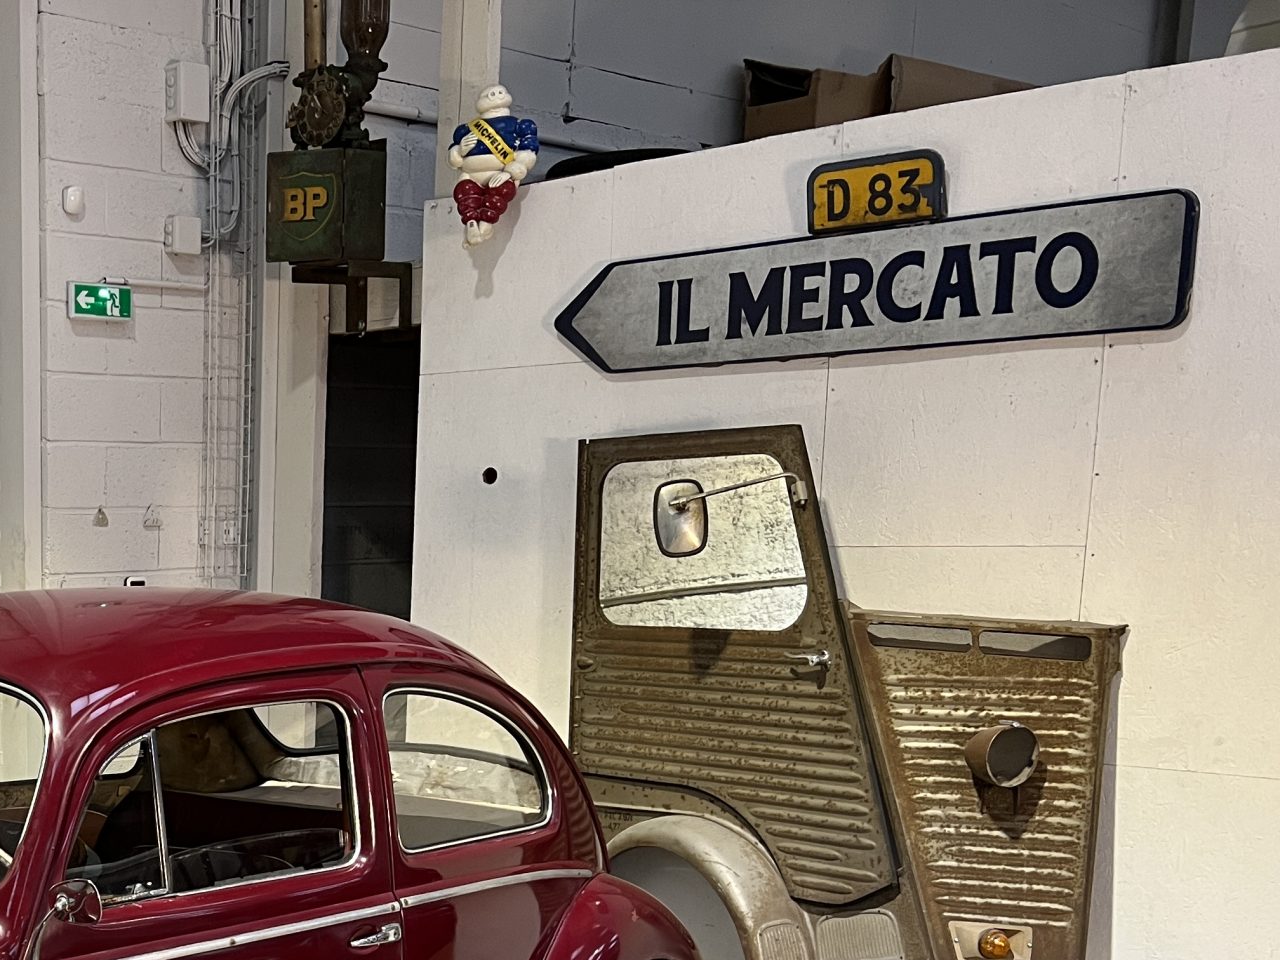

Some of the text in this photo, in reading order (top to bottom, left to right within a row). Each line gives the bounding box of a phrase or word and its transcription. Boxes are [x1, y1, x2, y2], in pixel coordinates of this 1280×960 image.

[473, 120, 509, 160] MICHELIN
[281, 186, 328, 222] BP
[827, 167, 921, 222] D 83
[655, 231, 1100, 347] IL MERCATO
